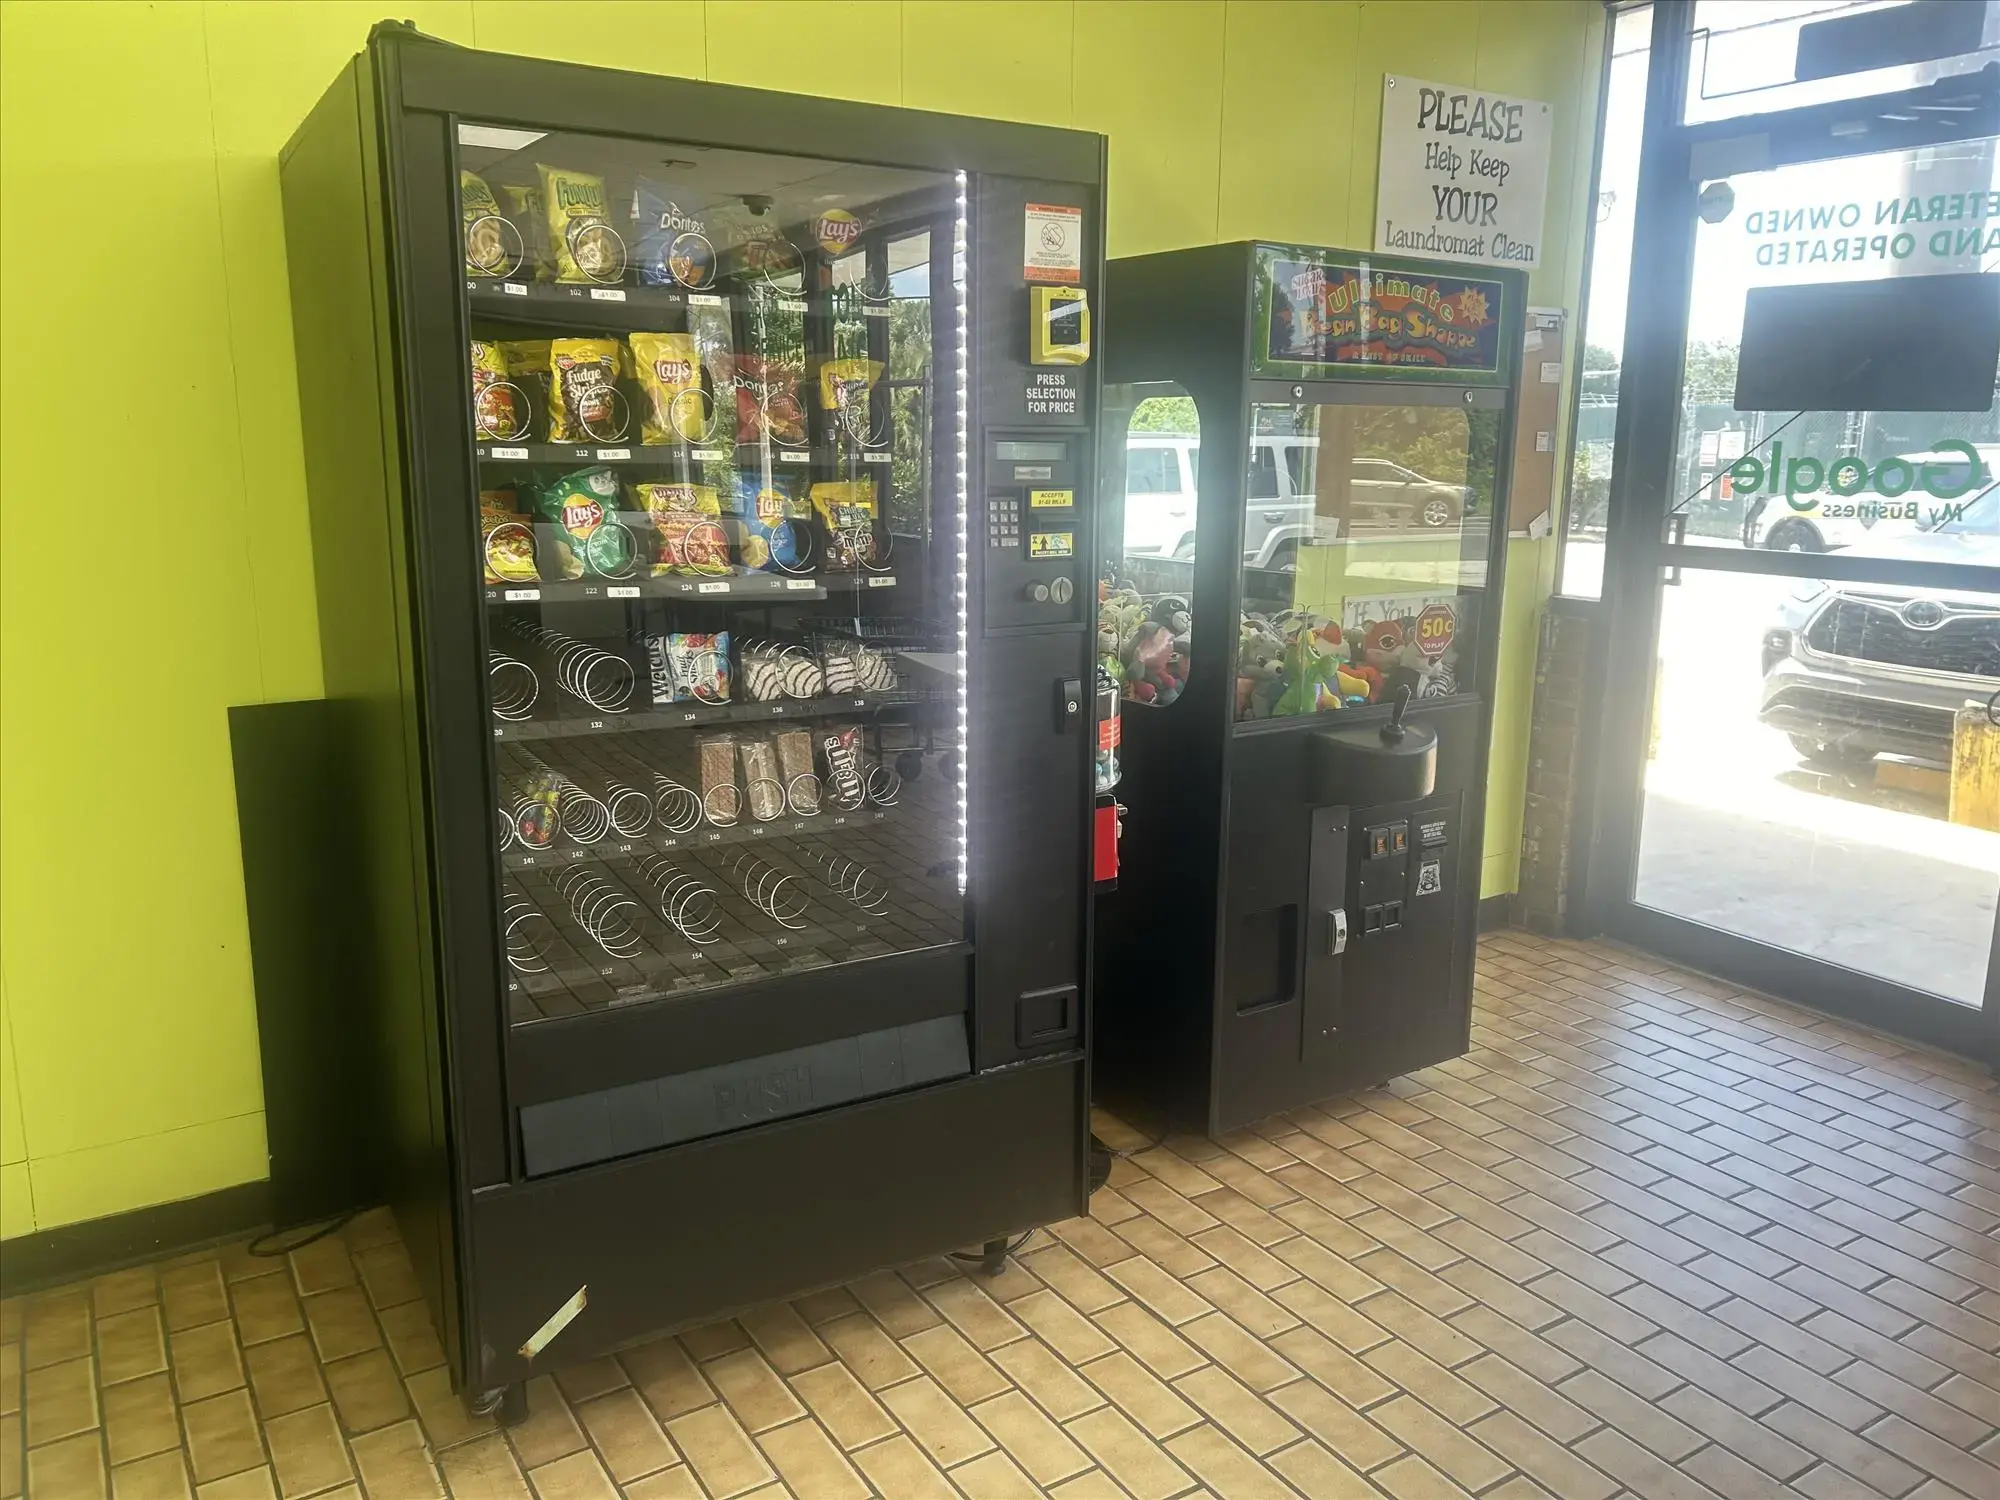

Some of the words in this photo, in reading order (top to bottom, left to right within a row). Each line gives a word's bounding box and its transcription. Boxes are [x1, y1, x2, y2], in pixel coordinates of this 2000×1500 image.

[1417, 87, 1523, 144] PLEASE
[1424, 141, 1462, 180] Help
[1469, 149, 1510, 187] Keep
[1432, 184, 1498, 227] YOUR
[660, 213, 706, 234] Doritos
[1385, 220, 1485, 257] Laundromat
[1491, 233, 1534, 262] Clean
[570, 288, 581, 296] 102
[669, 294, 680, 302] 104
[1406, 311, 1476, 349] Shoppe
[565, 366, 602, 382] Fudge
[1037, 374, 1065, 385] PRESS
[733, 375, 784, 395] Dorios
[1026, 387, 1075, 399] SELECTION
[1028, 401, 1046, 413] FOR
[1049, 401, 1074, 413] PRICE
[566, 503, 602, 530] Lay's
[586, 587, 597, 595] 122
[591, 721, 603, 729] 132
[665, 838, 676, 846] 144
[709, 833, 720, 841] 145
[620, 844, 631, 852] 143
[572, 851, 583, 859] 142
[523, 857, 534, 865] 141
[602, 967, 613, 975] 152
